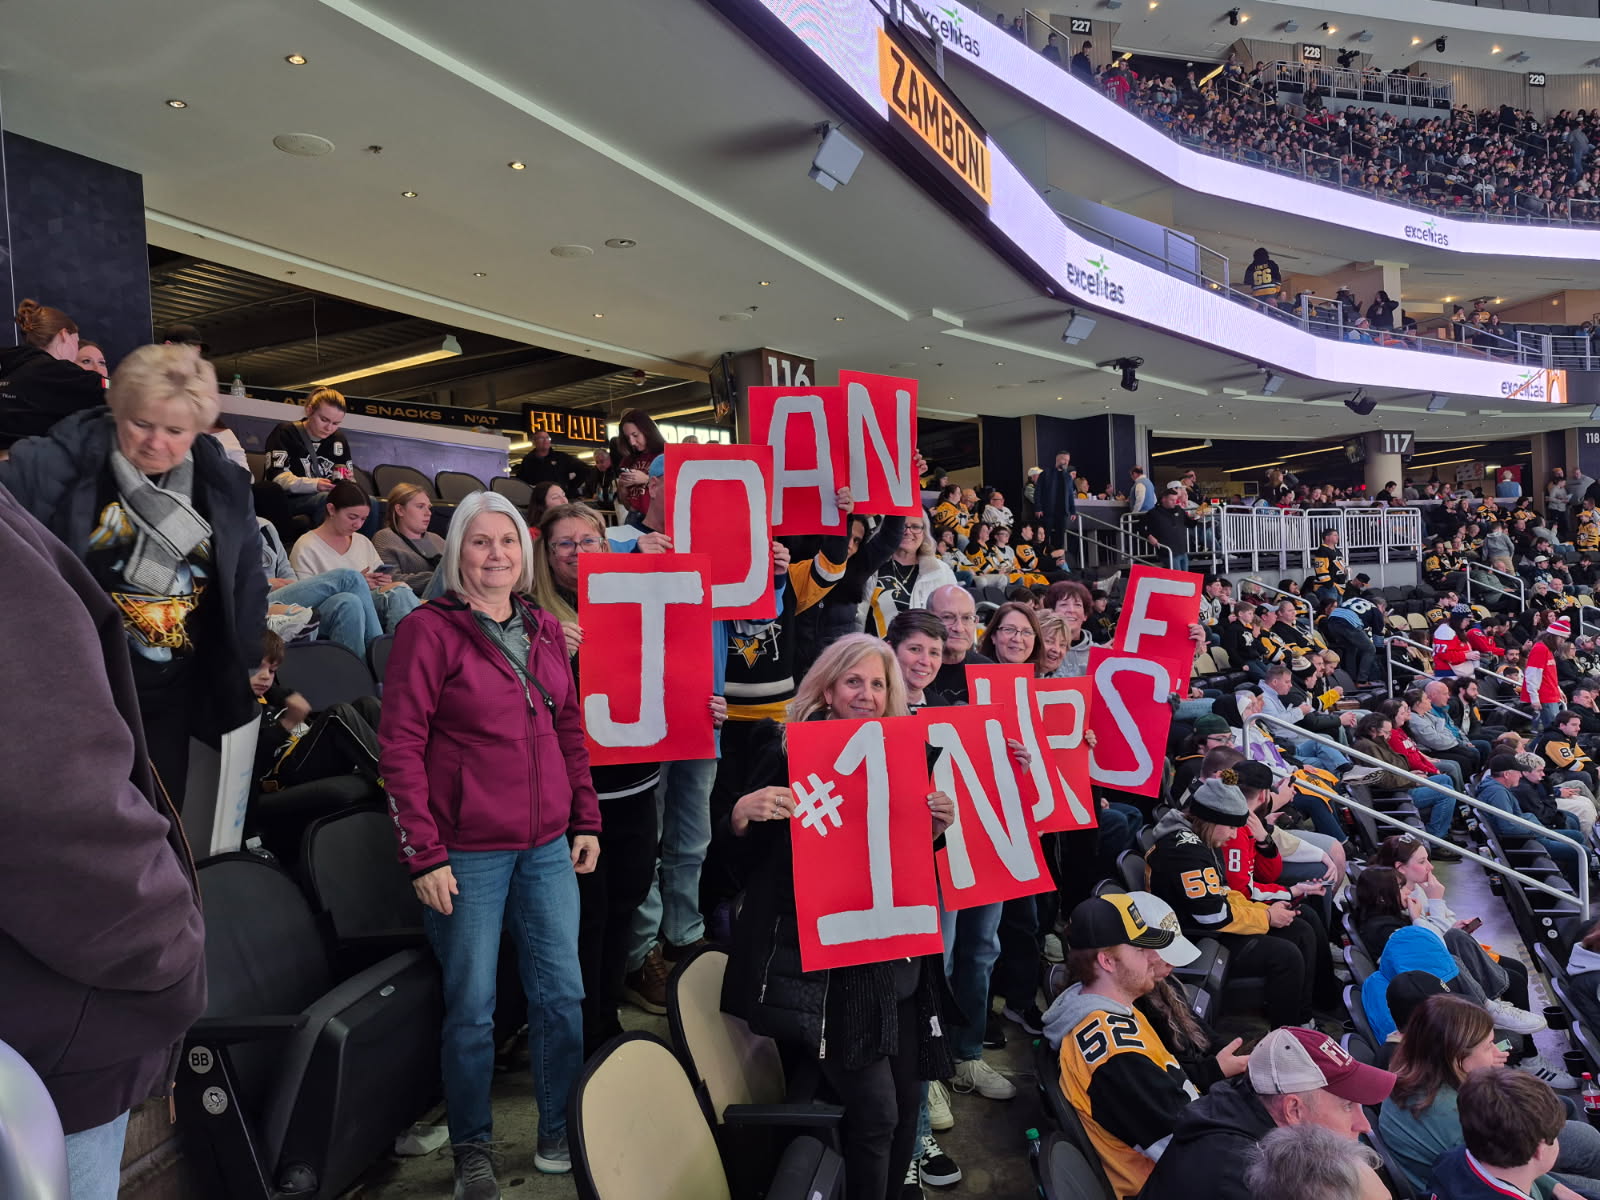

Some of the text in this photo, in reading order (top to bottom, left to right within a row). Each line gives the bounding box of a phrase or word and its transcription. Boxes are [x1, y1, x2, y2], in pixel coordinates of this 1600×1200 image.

[1072, 20, 1090, 32] 227
[1304, 46, 1321, 59] 228
[1529, 74, 1545, 85] 229
[890, 46, 986, 194] ZAMBONI
[1404, 225, 1449, 246] excelitas
[1066, 262, 1125, 304] excelitas
[1252, 267, 1272, 287] 66
[365, 404, 500, 426] SNACKS N'AT
[567, 414, 606, 442] AVE
[1585, 432, 1600, 444] 118
[1384, 433, 1412, 453] 117
[1199, 610, 1210, 622] 87
[793, 721, 939, 947] #1
[1228, 848, 1242, 873] 8
[1180, 867, 1220, 899] 59
[1076, 1014, 1146, 1064] 52
[192, 1053, 209, 1066] BB
